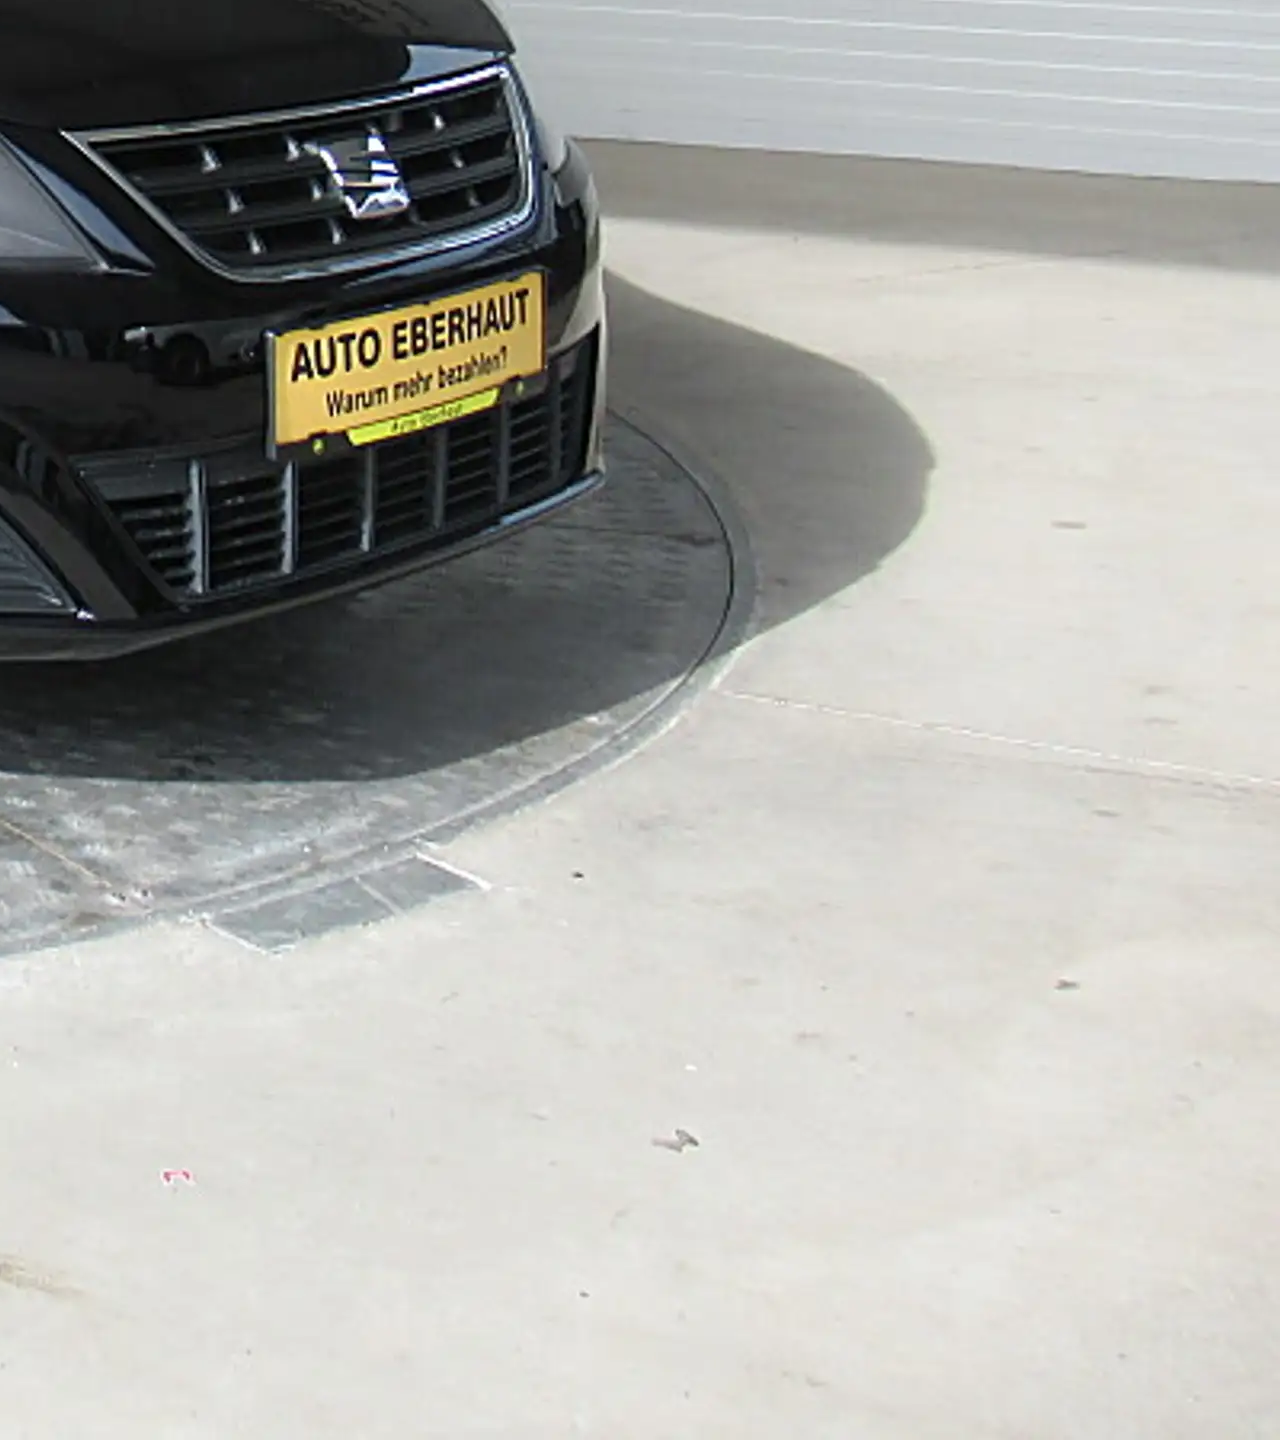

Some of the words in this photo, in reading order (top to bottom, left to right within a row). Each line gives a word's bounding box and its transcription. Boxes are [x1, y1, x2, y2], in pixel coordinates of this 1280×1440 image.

[290, 327, 382, 382] AUTO
[391, 287, 530, 361] EBERHAUT
[326, 385, 389, 417] Warum
[392, 371, 433, 401] mehr
[437, 345, 508, 389] bezahlen?
